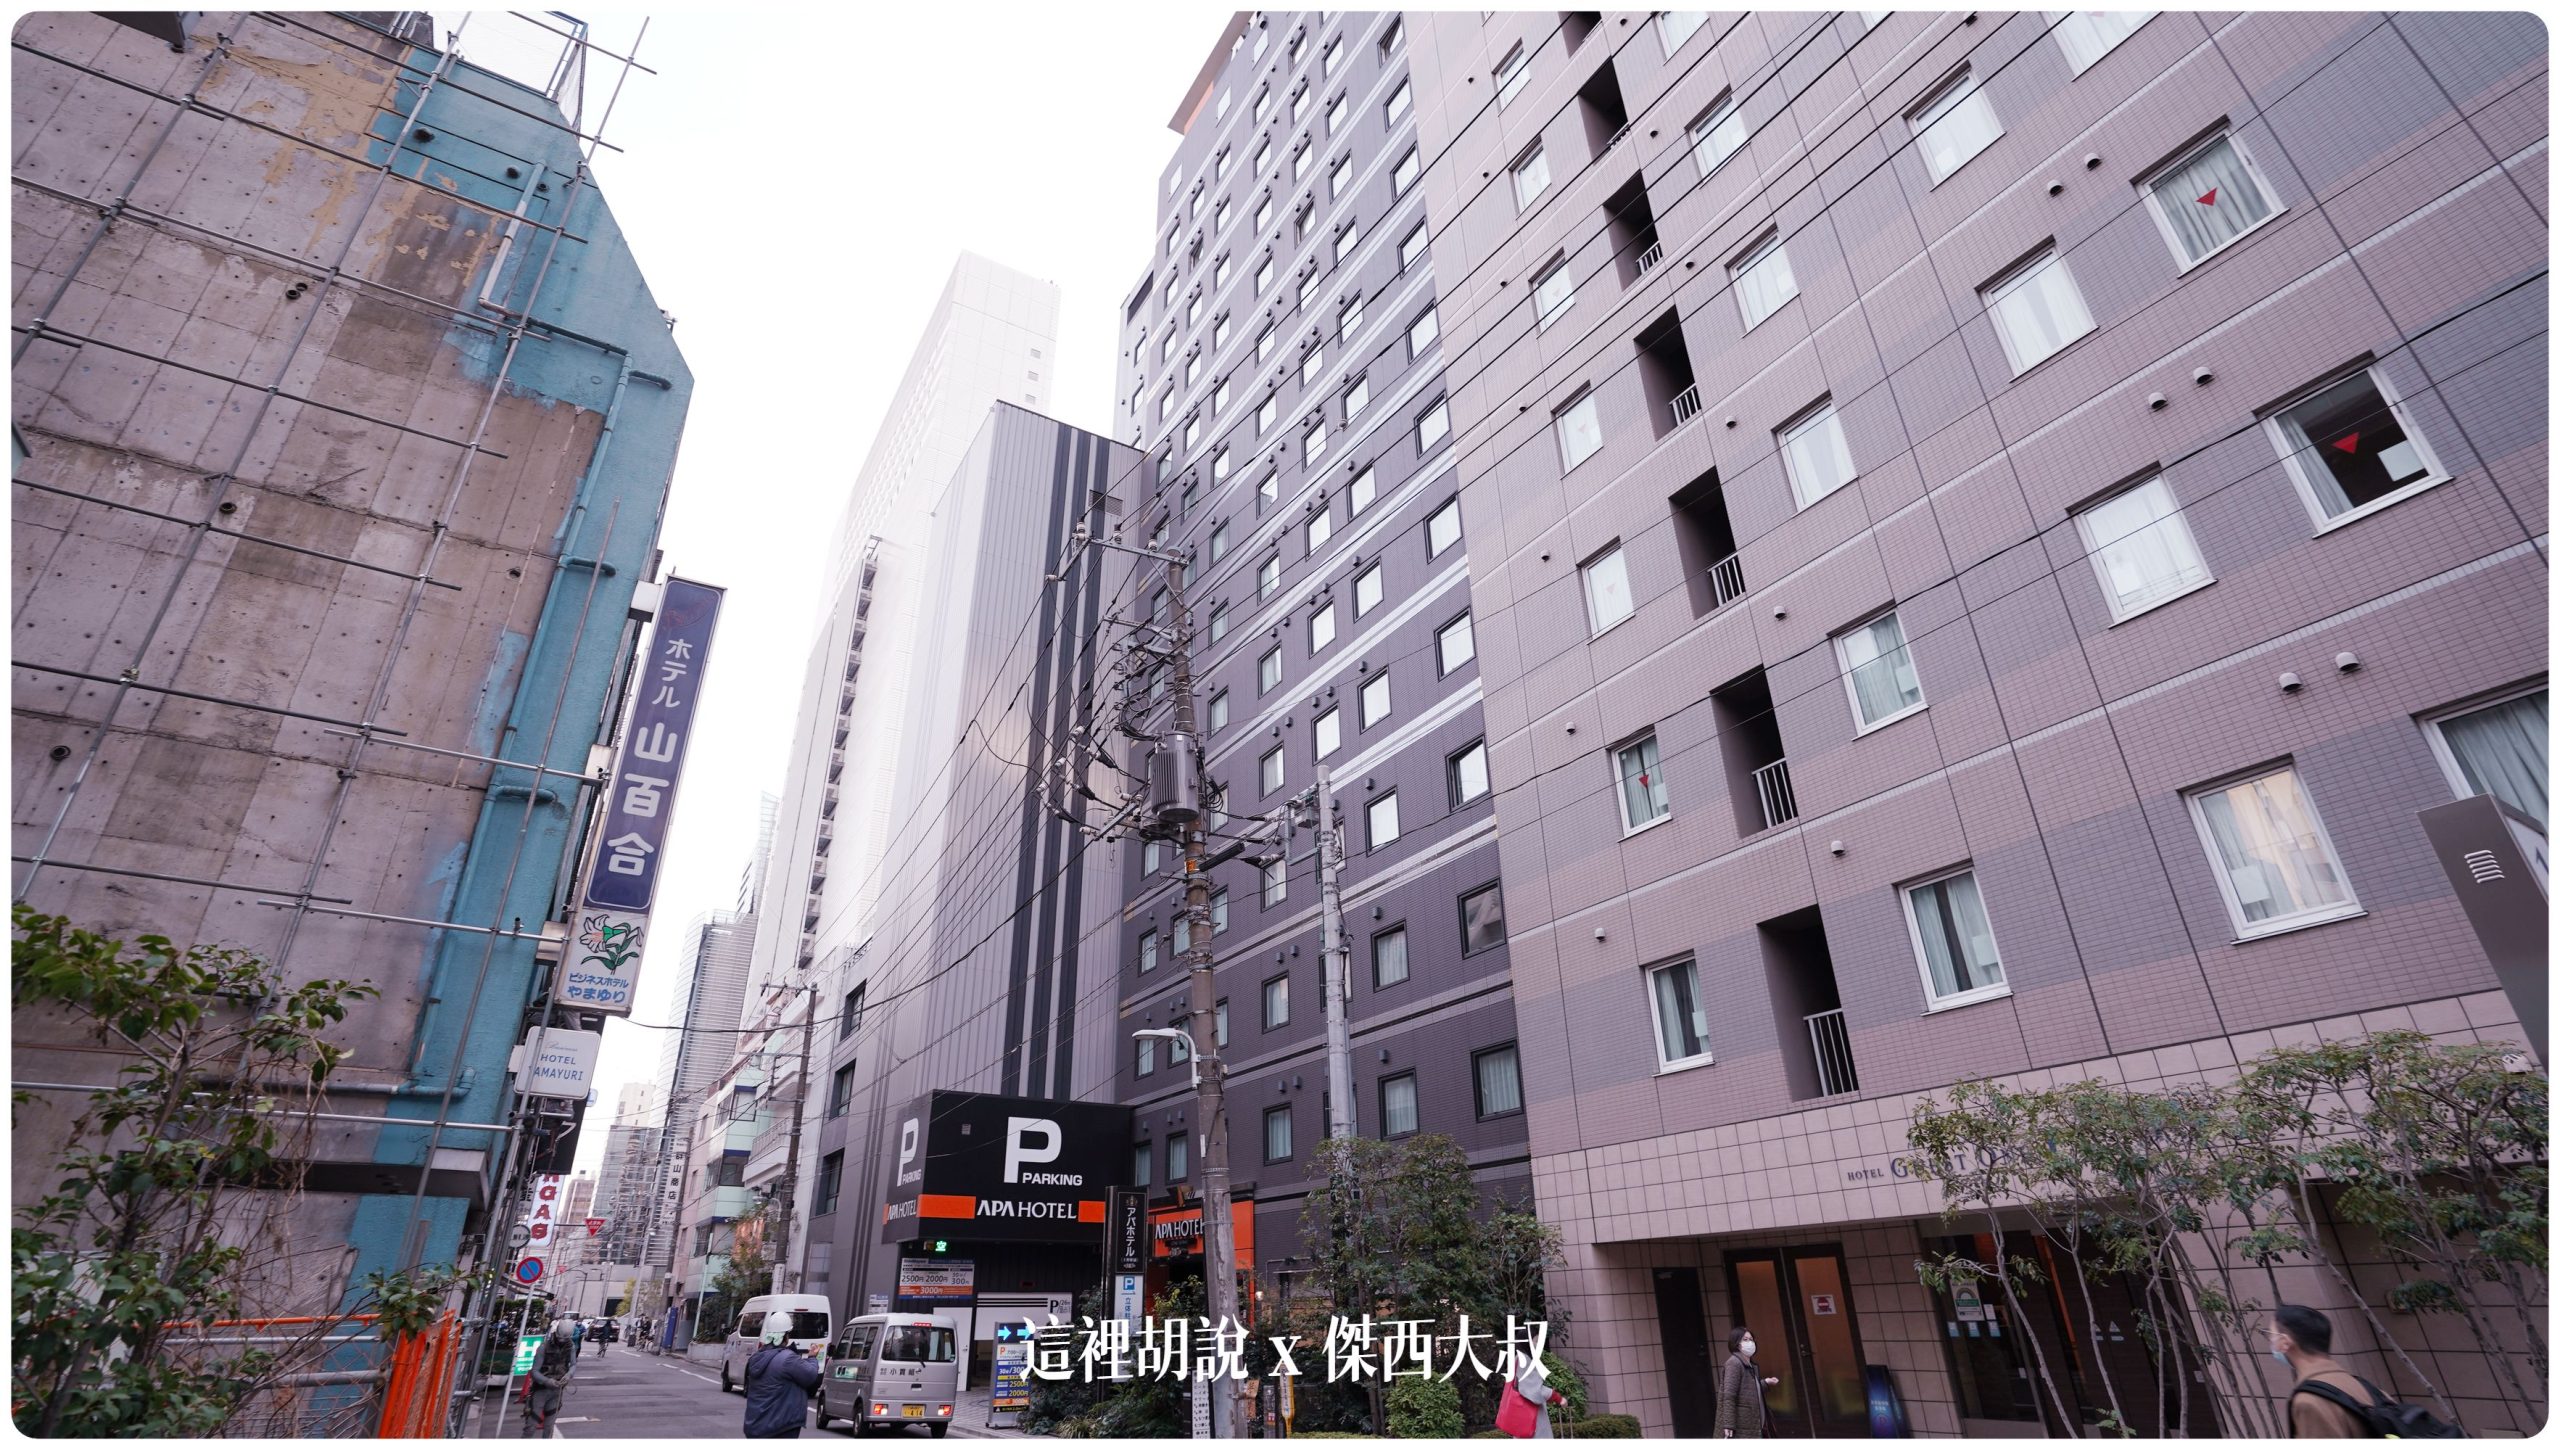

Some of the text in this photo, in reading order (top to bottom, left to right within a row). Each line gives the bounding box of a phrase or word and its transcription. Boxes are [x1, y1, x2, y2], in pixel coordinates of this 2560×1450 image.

[607, 638, 693, 877] ホテル 山百合
[569, 973, 629, 988] ビジネスホテル
[567, 986, 626, 1003] やまゆり
[540, 1054, 576, 1065] HOTEL
[528, 1065, 583, 1081] AMAYURI
[897, 1118, 919, 1187] P
[1004, 1116, 1062, 1184] P
[902, 1168, 922, 1185] PARKING
[1022, 1172, 1083, 1186] PARKING
[1847, 1168, 1885, 1181] HOTEL
[888, 1199, 917, 1221] APA HOTEL
[977, 1199, 1077, 1219] APA HOTEL
[1125, 1207, 1137, 1257] アパホテル
[1155, 1223, 1172, 1240] APA
